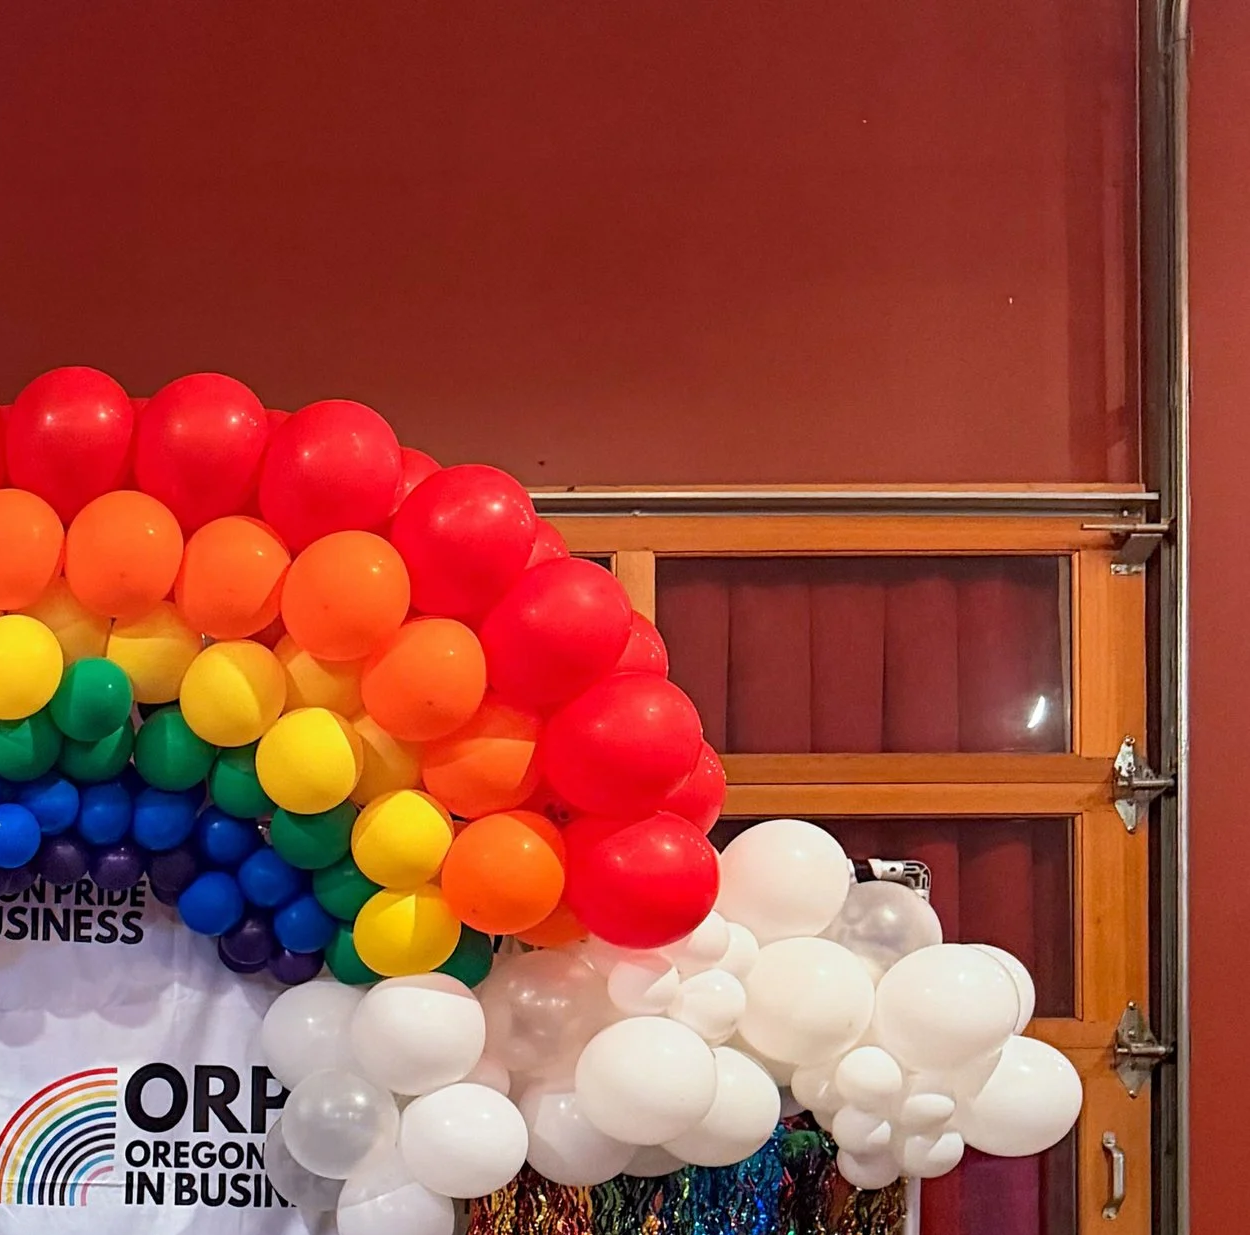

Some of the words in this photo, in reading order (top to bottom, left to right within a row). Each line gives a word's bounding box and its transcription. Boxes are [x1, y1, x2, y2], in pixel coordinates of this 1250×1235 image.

[54, 878, 147, 907] PRIDE
[124, 1062, 292, 1134] ORP
[125, 1140, 265, 1169] OREGON
[125, 1171, 165, 1205] IN
